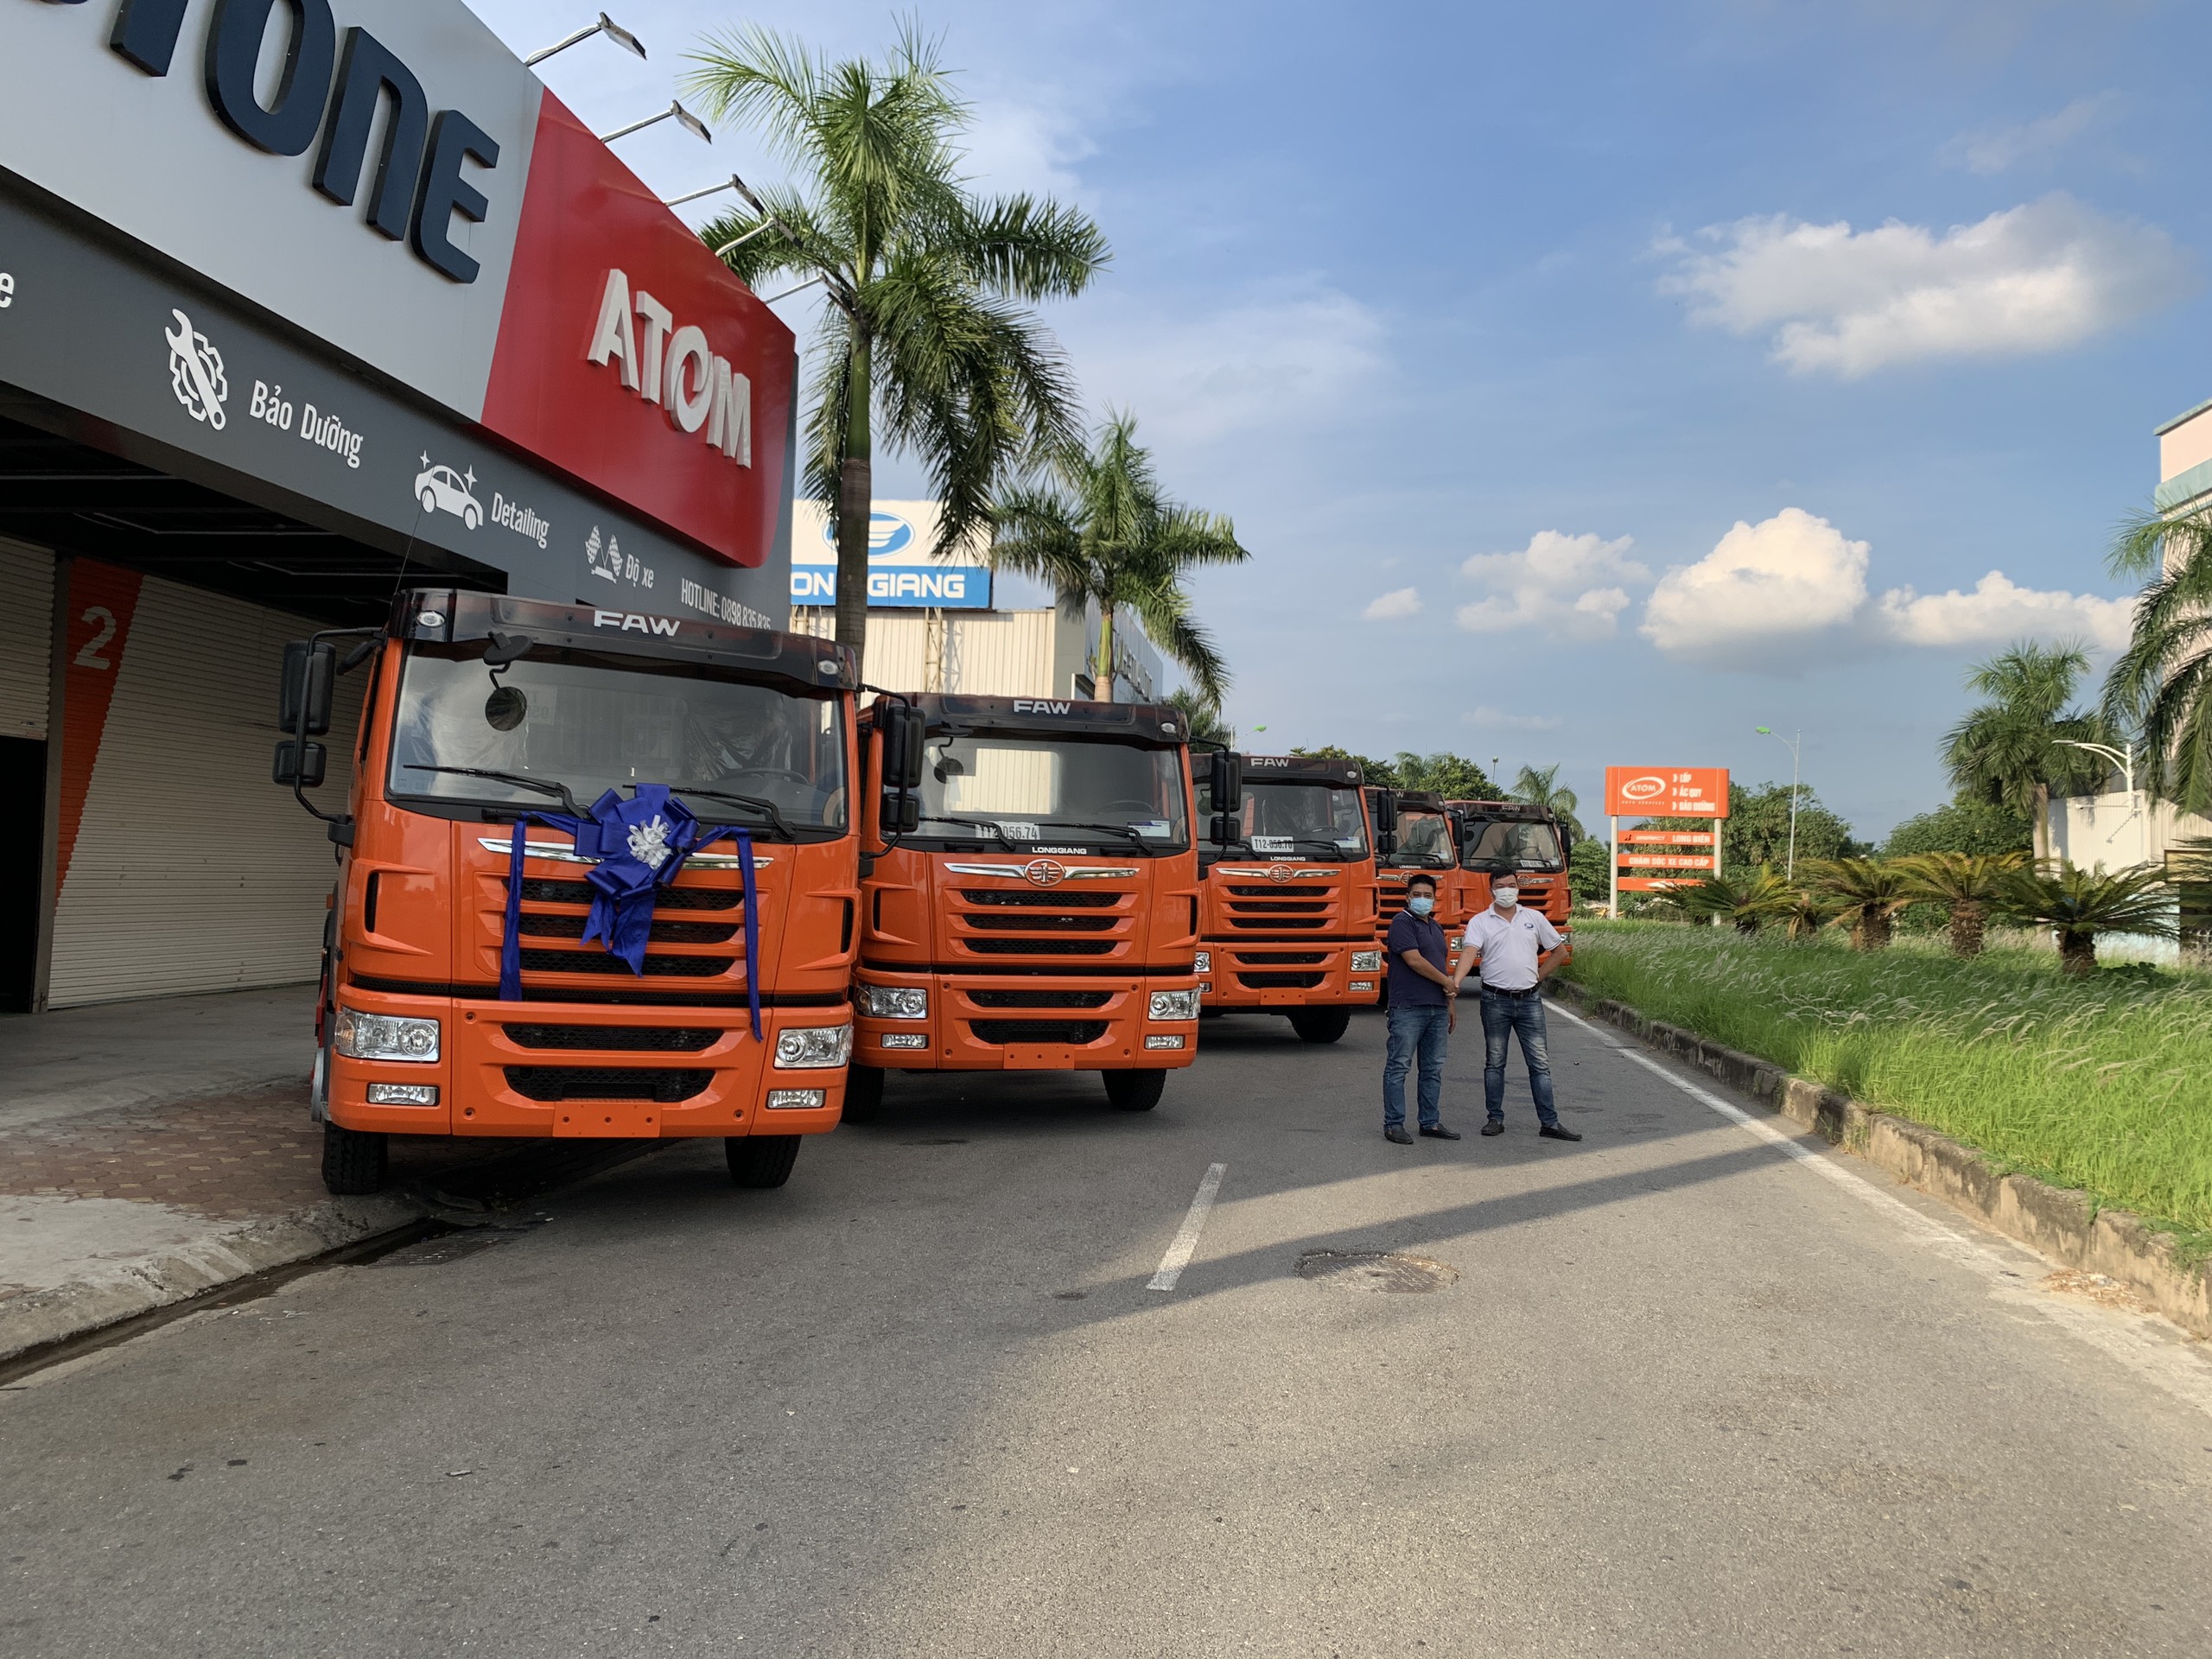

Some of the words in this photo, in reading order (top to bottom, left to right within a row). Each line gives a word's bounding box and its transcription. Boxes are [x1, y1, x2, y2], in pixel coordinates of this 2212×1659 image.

[587, 268, 752, 469] ATOM
[249, 379, 293, 430] Bảo
[300, 403, 364, 469] Dưỡng
[491, 492, 550, 550] Detailing
[625, 553, 640, 588] Độ
[641, 567, 654, 588] xe
[868, 573, 965, 599] GIANG
[681, 577, 721, 619] HOTLINE:
[721, 596, 742, 626] 0898
[73, 606, 117, 671] 2
[594, 609, 681, 637] FAW
[1014, 699, 1071, 715] FAW
[1250, 758, 1289, 767] FAW
[1630, 784, 1656, 792] ATOM
